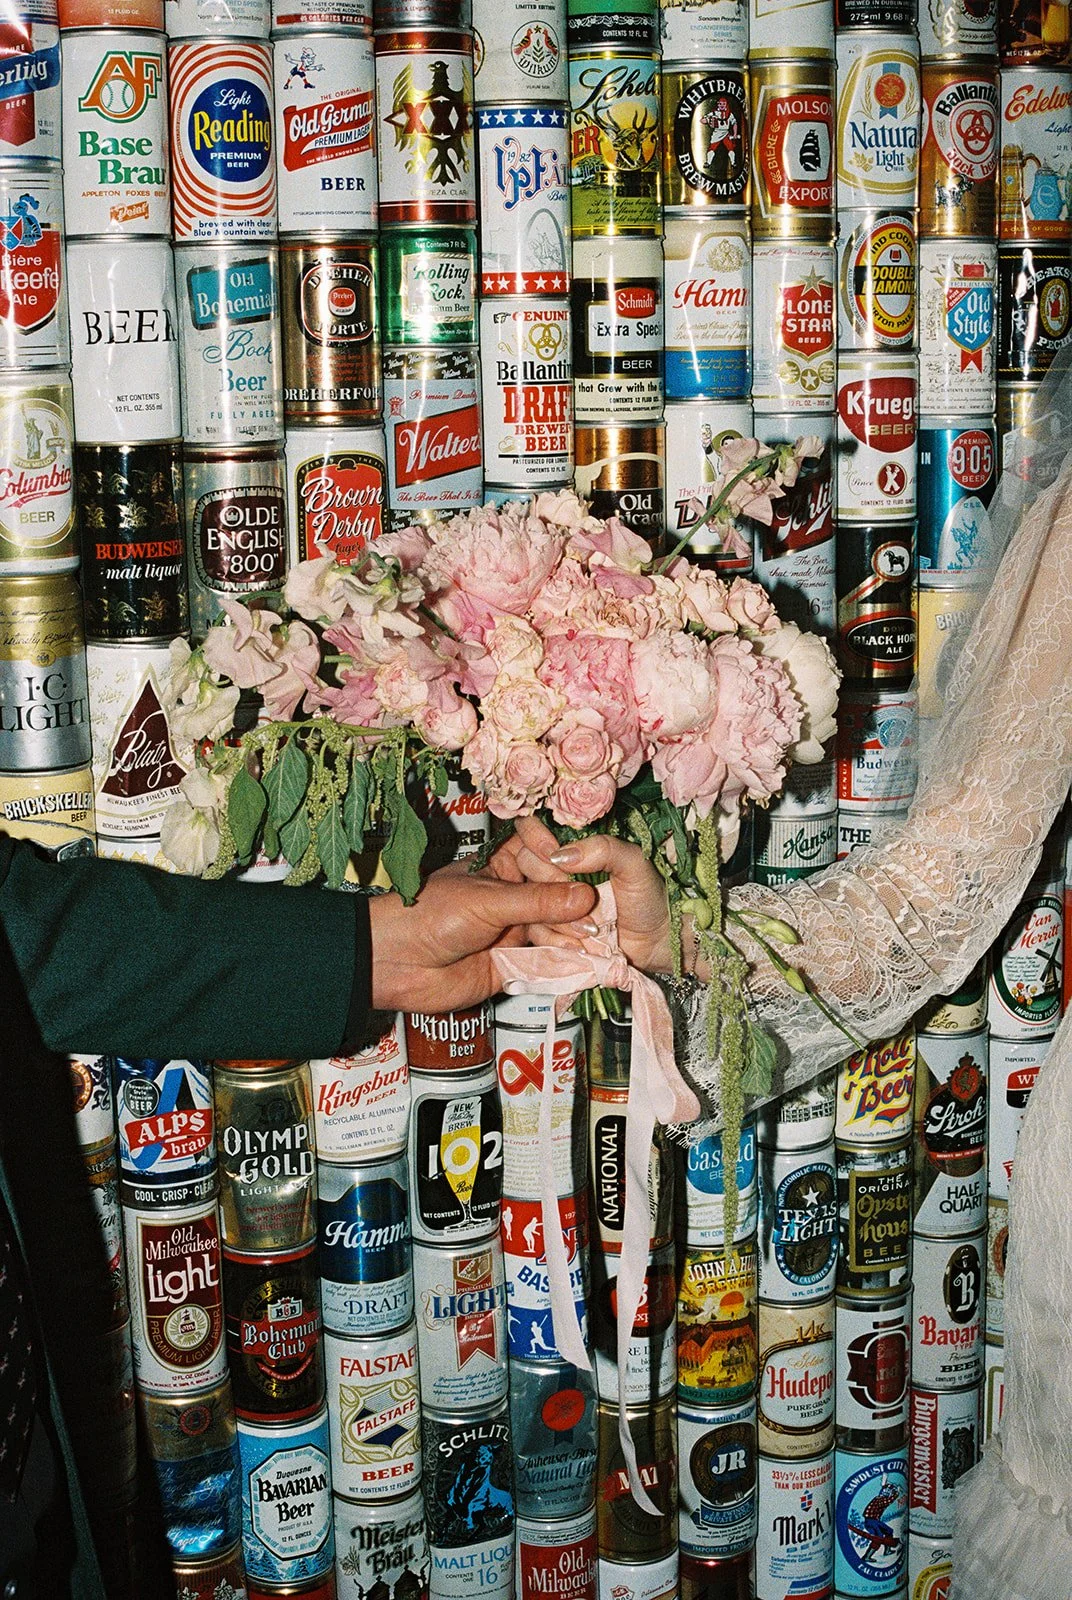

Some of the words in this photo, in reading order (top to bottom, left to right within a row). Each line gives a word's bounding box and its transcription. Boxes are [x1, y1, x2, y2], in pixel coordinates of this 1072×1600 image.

[850, 13, 866, 21] 275
[214, 89, 251, 110] Light
[335, 88, 362, 98] ORIGINAL
[6, 98, 26, 110] BEER
[193, 110, 270, 151] Reading
[290, 111, 319, 141] Old
[78, 131, 152, 156] Base
[314, 132, 353, 147] PREMIUM
[354, 125, 371, 140] LAGER
[210, 152, 261, 160] PREMIUM
[769, 134, 778, 167] BIERE
[876, 151, 905, 172] Light
[321, 178, 365, 191] BEER
[2, 254, 42, 266] Bière
[230, 272, 254, 288] Old
[871, 266, 913, 280] DOUBLE
[11, 293, 37, 305] Ale
[618, 293, 653, 310] Schmidt
[786, 300, 832, 314] LONE
[967, 291, 990, 314] Old
[454, 304, 470, 312] Beer
[596, 322, 629, 337] Extra
[786, 318, 832, 333] STAR
[953, 309, 991, 343] Style
[622, 360, 652, 369] BEER
[219, 369, 266, 393] Beer
[579, 383, 593, 393] that
[597, 384, 623, 393] Grew
[626, 383, 645, 393] with
[647, 383, 657, 392] the
[117, 394, 128, 402] NET
[130, 393, 160, 402] CONTENTS
[868, 423, 914, 436] BEER
[525, 437, 567, 453] BEER
[962, 474, 985, 483] BEER
[301, 477, 384, 513] Brown
[397, 492, 412, 502] The
[414, 492, 438, 502] Beer
[440, 491, 462, 501] That
[678, 488, 694, 497] The
[619, 495, 652, 510] Old
[19, 511, 55, 523] BEER
[220, 506, 279, 527] OLDE
[312, 512, 376, 544] Derby
[795, 556, 813, 565] The
[106, 564, 142, 580] malt
[791, 568, 811, 577] made
[853, 635, 894, 646] BLACK
[886, 646, 903, 654] ALE
[108, 710, 177, 788] Blatz
[147, 791, 168, 801] FINEST
[71, 812, 87, 823] BEER
[840, 828, 871, 843] THE
[1010, 923, 1062, 950] Merritt
[1015, 1005, 1042, 1021] IMPORTED
[449, 1043, 475, 1057] Beer
[317, 1064, 409, 1116] Kingsbury
[366, 1088, 397, 1105] BEER
[854, 1074, 912, 1121] Beer
[130, 1102, 152, 1111] BEER
[453, 1102, 473, 1112] NEW
[324, 1113, 366, 1126] RECYCLABLE
[368, 1105, 406, 1119] ALUMINUM
[139, 1111, 206, 1144] ALPS
[448, 1120, 473, 1131] BREW
[342, 1130, 368, 1140] CONTENTS
[171, 1136, 206, 1157] brau
[240, 1152, 314, 1184] GOLD
[602, 1122, 618, 1222] NATIONAL
[780, 1167, 810, 1207] NON-ALCOHOLIC
[812, 1164, 826, 1173] MALT
[879, 1173, 904, 1186] THE
[948, 1182, 979, 1199] HALF
[478, 1202, 490, 1211] FLUID
[939, 1195, 983, 1214] QUART
[434, 1210, 460, 1218] CONTENTS
[172, 1227, 194, 1244] Old
[780, 1218, 836, 1242] LIGHT
[146, 1237, 218, 1261] Milwaukee
[688, 1259, 726, 1282] JOHN
[729, 1258, 738, 1273] A
[800, 1268, 828, 1285] CALORIES
[146, 1255, 219, 1304] Light
[457, 1283, 491, 1293] PREMIUM
[151, 1321, 182, 1362] PREMIUM
[186, 1340, 213, 1363] LIGHT
[270, 1340, 306, 1359] Club
[954, 1342, 973, 1350] TYPE
[787, 1404, 808, 1412] PURE
[800, 1408, 823, 1418] BEER
[356, 1398, 416, 1436] FALSTAFF
[911, 1396, 937, 1504] Burgemeister
[712, 1450, 746, 1474] JR
[276, 1465, 312, 1480] Duquesne
[362, 1462, 414, 1481] BEER
[360, 1486, 388, 1494] CONTENTS
[397, 1481, 410, 1489] FLUID
[846, 1466, 884, 1495] SAWDUST
[275, 1502, 315, 1524] Beer
[295, 1531, 312, 1539] OUNCES
[773, 1508, 823, 1548] Mark
[693, 1544, 725, 1553] IMPORTED
[434, 1557, 476, 1570] MALT
[559, 1548, 585, 1575] Old
[478, 1566, 498, 1586] 16
